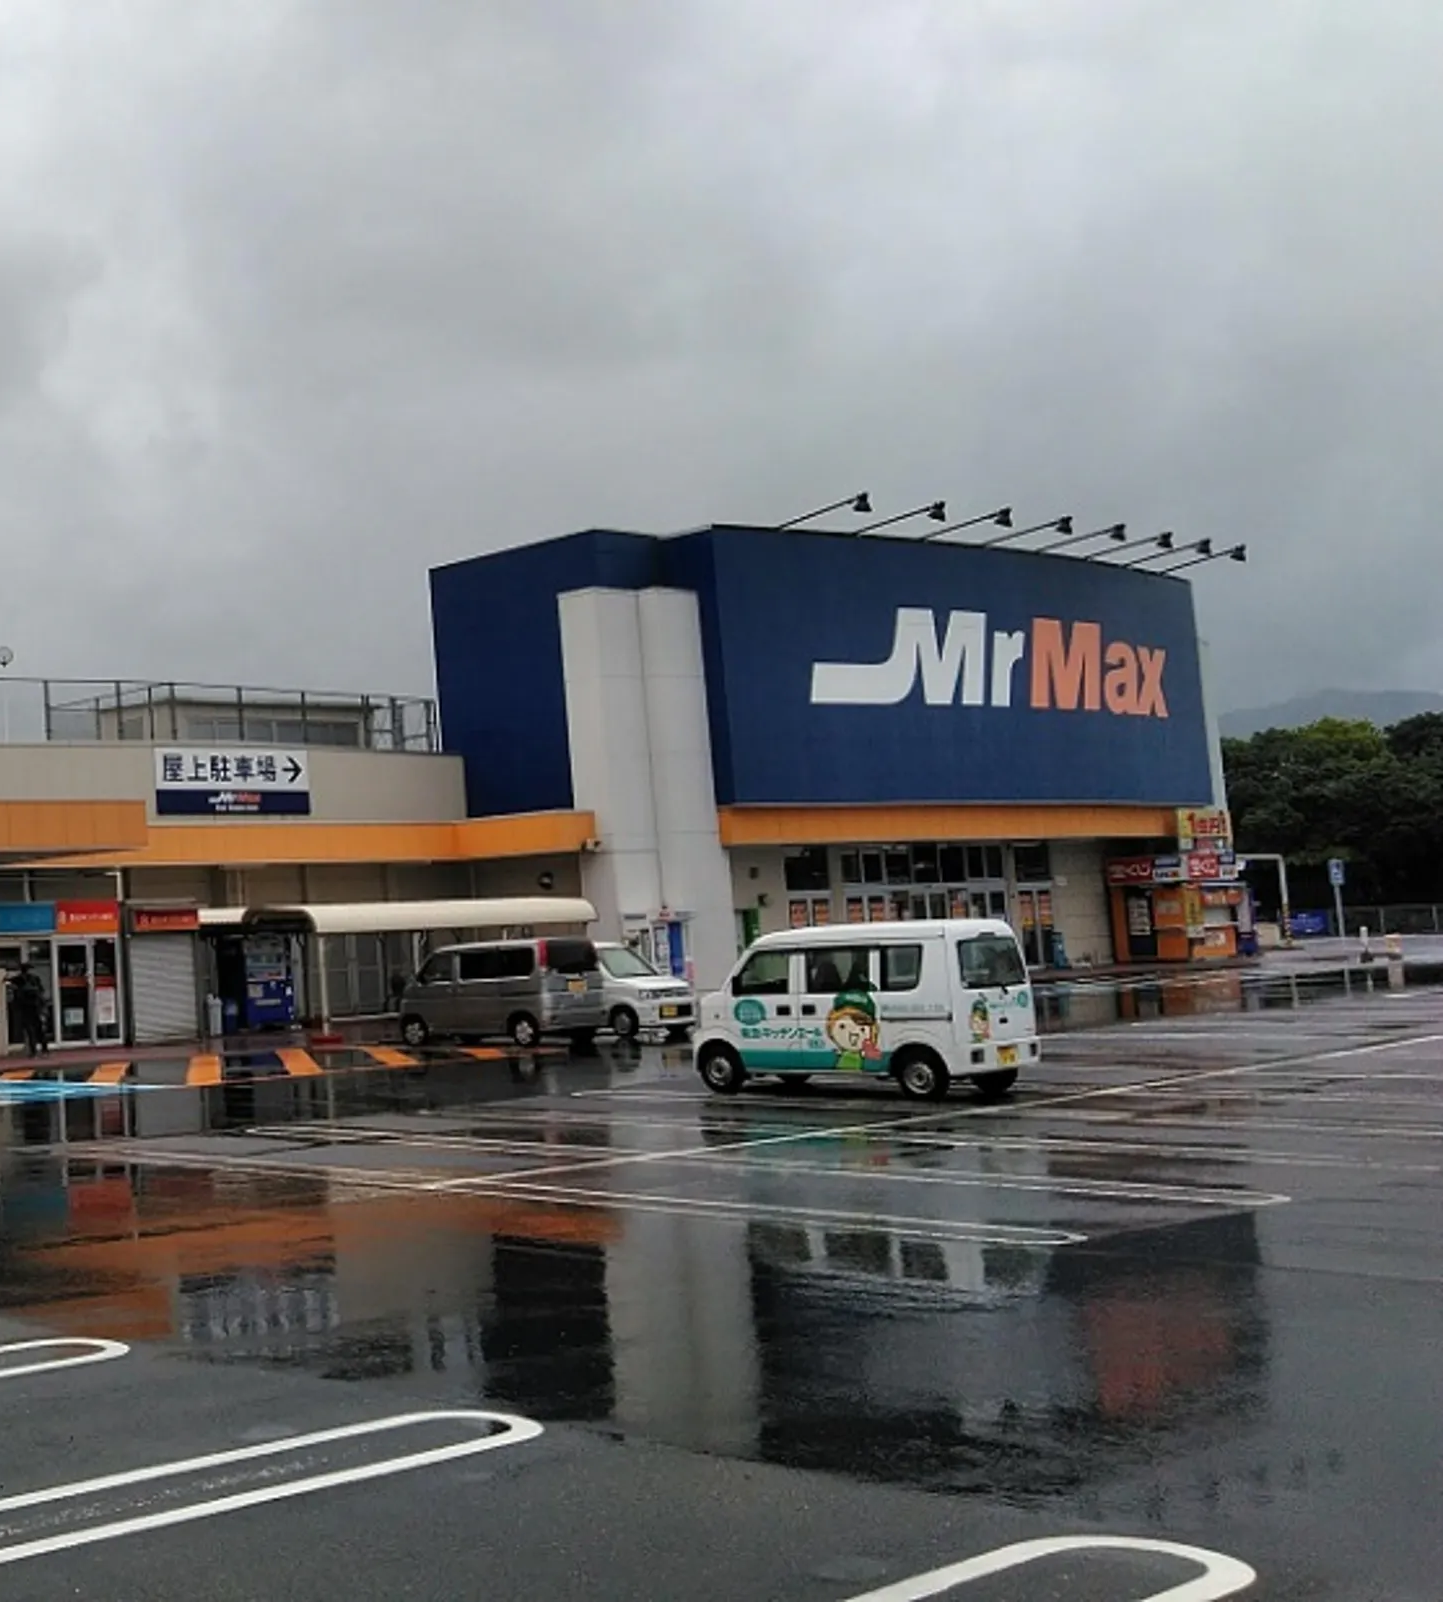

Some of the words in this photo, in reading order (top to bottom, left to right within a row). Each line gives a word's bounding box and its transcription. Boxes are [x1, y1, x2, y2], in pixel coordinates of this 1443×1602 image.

[163, 754, 277, 782] 屋上駐車場
